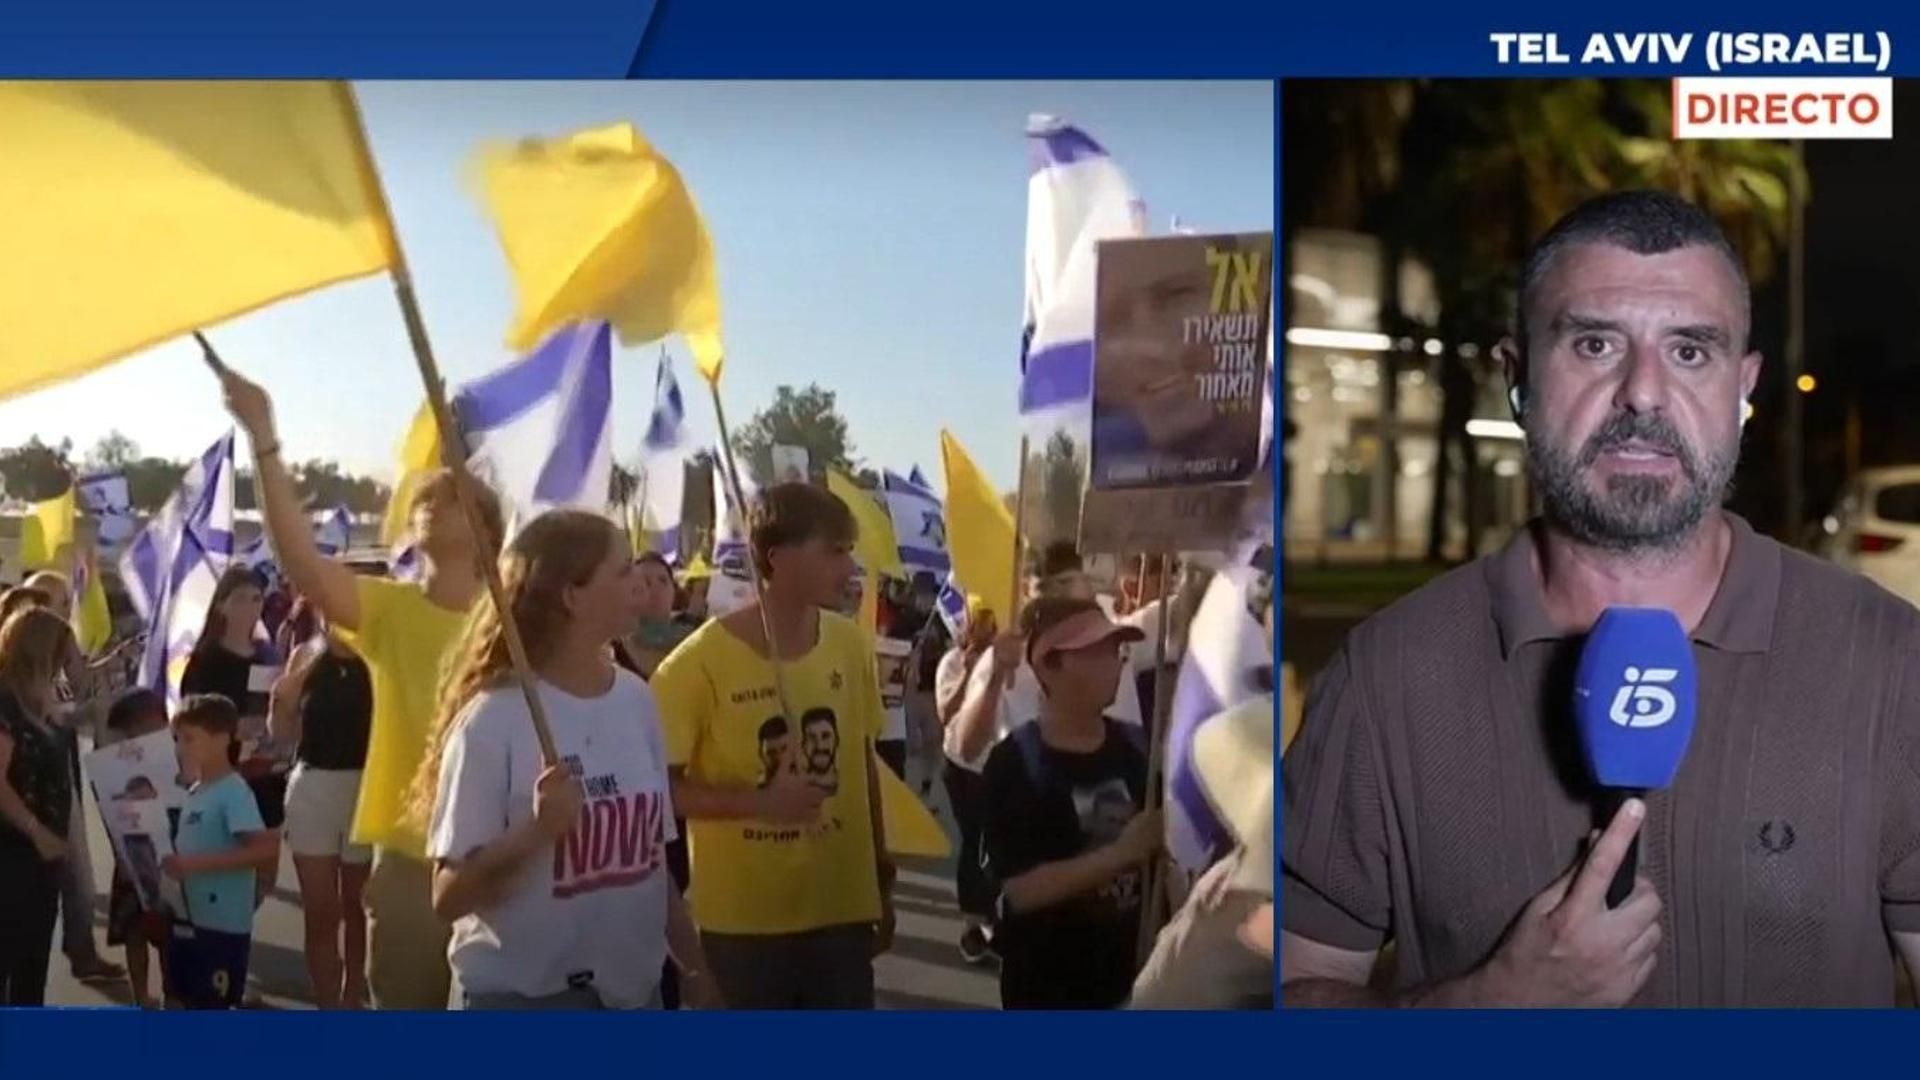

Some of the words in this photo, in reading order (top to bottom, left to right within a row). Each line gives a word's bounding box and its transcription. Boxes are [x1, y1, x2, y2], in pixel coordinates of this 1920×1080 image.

[1205, 246, 1261, 312] אל
[1213, 342, 1257, 371] אותי
[1195, 371, 1254, 401] מאחור
